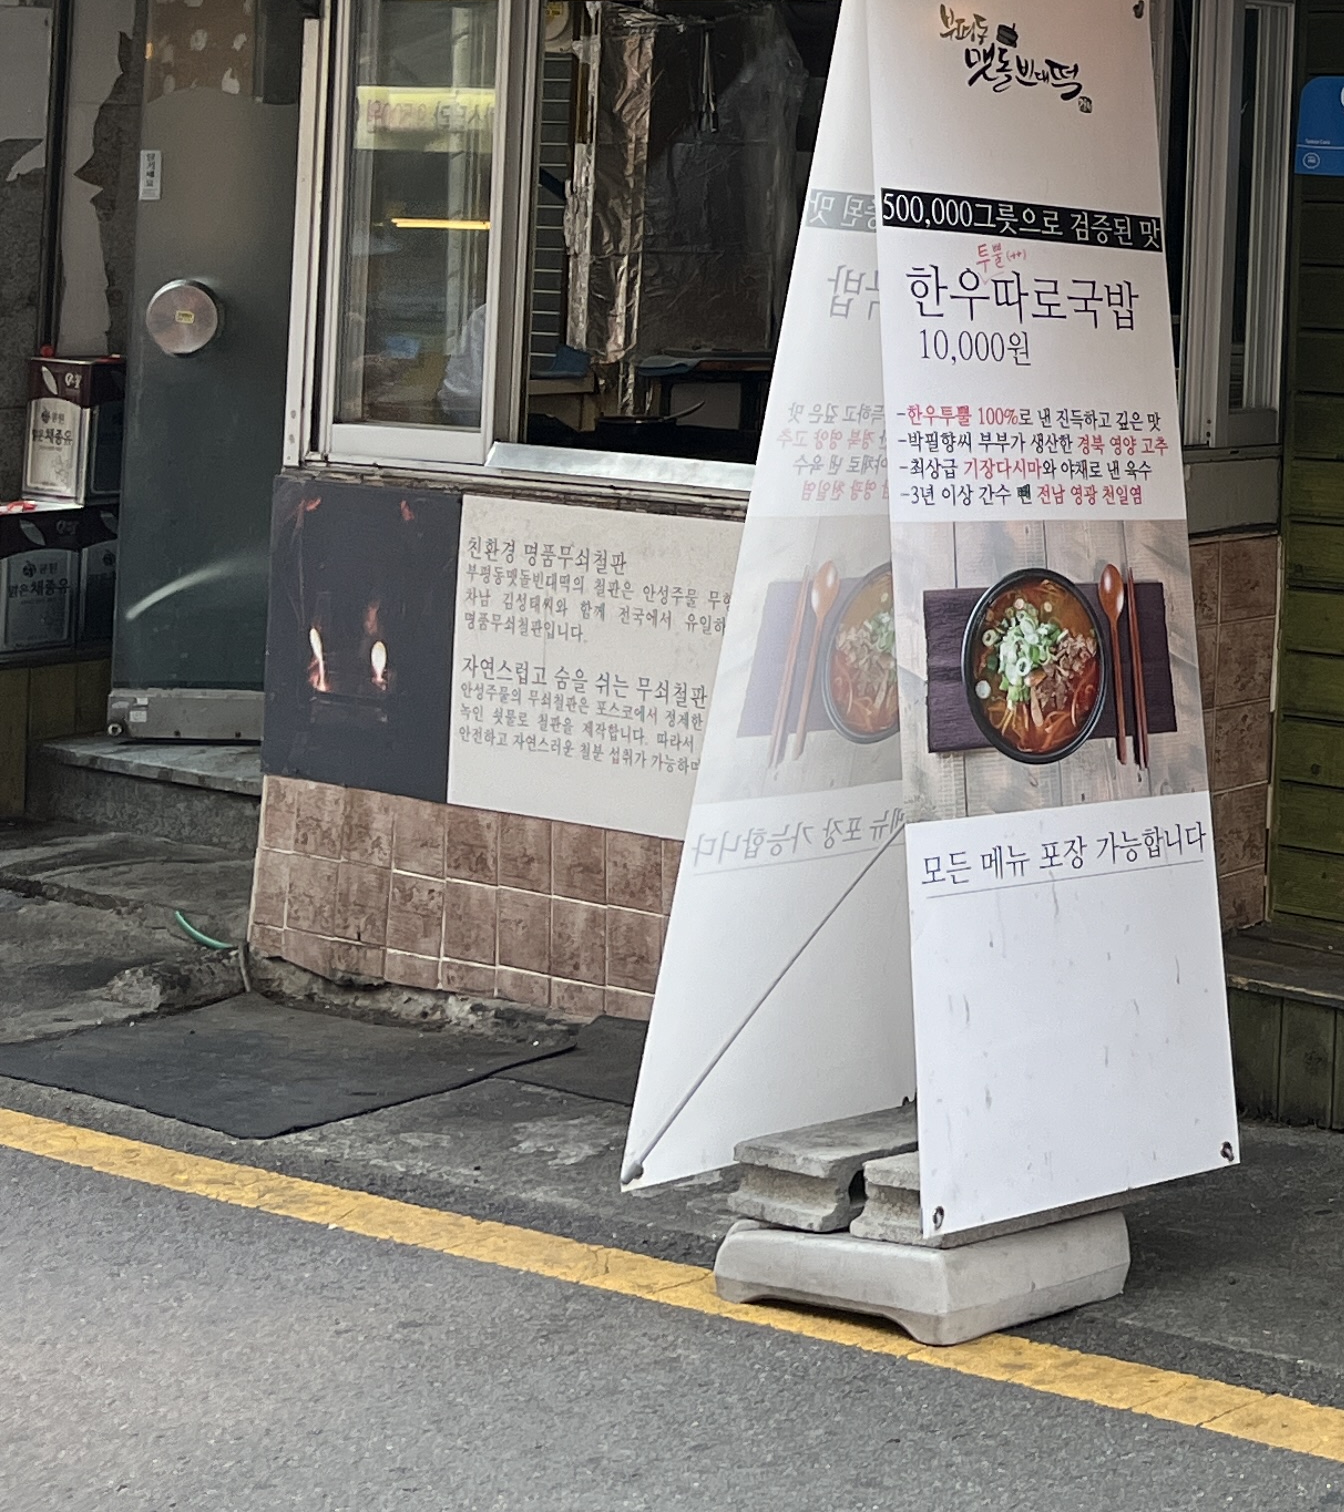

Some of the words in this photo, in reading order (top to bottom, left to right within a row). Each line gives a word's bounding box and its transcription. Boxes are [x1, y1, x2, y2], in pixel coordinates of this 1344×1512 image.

[940, 3, 988, 45] 부평동
[882, 194, 1063, 236] 500,000그릇으로
[1071, 211, 1133, 246] 검증된
[1139, 219, 1161, 249] 맛
[906, 264, 1139, 331] 한우따로국밥
[920, 329, 1031, 366] 10,000원
[978, 407, 1034, 426] 100%로
[1037, 407, 1052, 428] 낸
[1056, 408, 1112, 431] 진득하고
[1116, 411, 1144, 431] 깊은
[1147, 412, 1161, 432] 맛
[978, 432, 1026, 454] 부부가
[1030, 433, 1073, 454] 생산한
[1077, 434, 1105, 456] 경북
[1109, 435, 1137, 456] 영양
[1141, 436, 1169, 456] 고추
[964, 458, 1057, 481] 기장다시마와
[1061, 458, 1103, 480] 야채로
[1106, 459, 1121, 481] 낸
[1124, 460, 1153, 481] 육수
[941, 483, 974, 506] 이상
[979, 483, 1012, 506] 간수
[1037, 484, 1066, 505] 전남
[1070, 484, 1098, 506] 영광
[1102, 484, 1142, 506] 천일염
[467, 536, 515, 564] 친환경
[524, 542, 627, 576] 명품무쇠철판
[643, 583, 699, 609] 안성주물
[619, 605, 671, 631] 전국에서
[461, 653, 548, 686] 자연스럽고
[554, 665, 588, 694] 숨을
[595, 671, 629, 699] 쉬는
[636, 676, 708, 710] 무쇠철판
[595, 700, 658, 726] 포스코에서
[657, 730, 694, 754] 따라서
[921, 850, 972, 886] 모든
[981, 845, 1030, 880] 메뉴
[1039, 835, 1087, 871] 포장
[1096, 820, 1206, 865] 가능합니다
